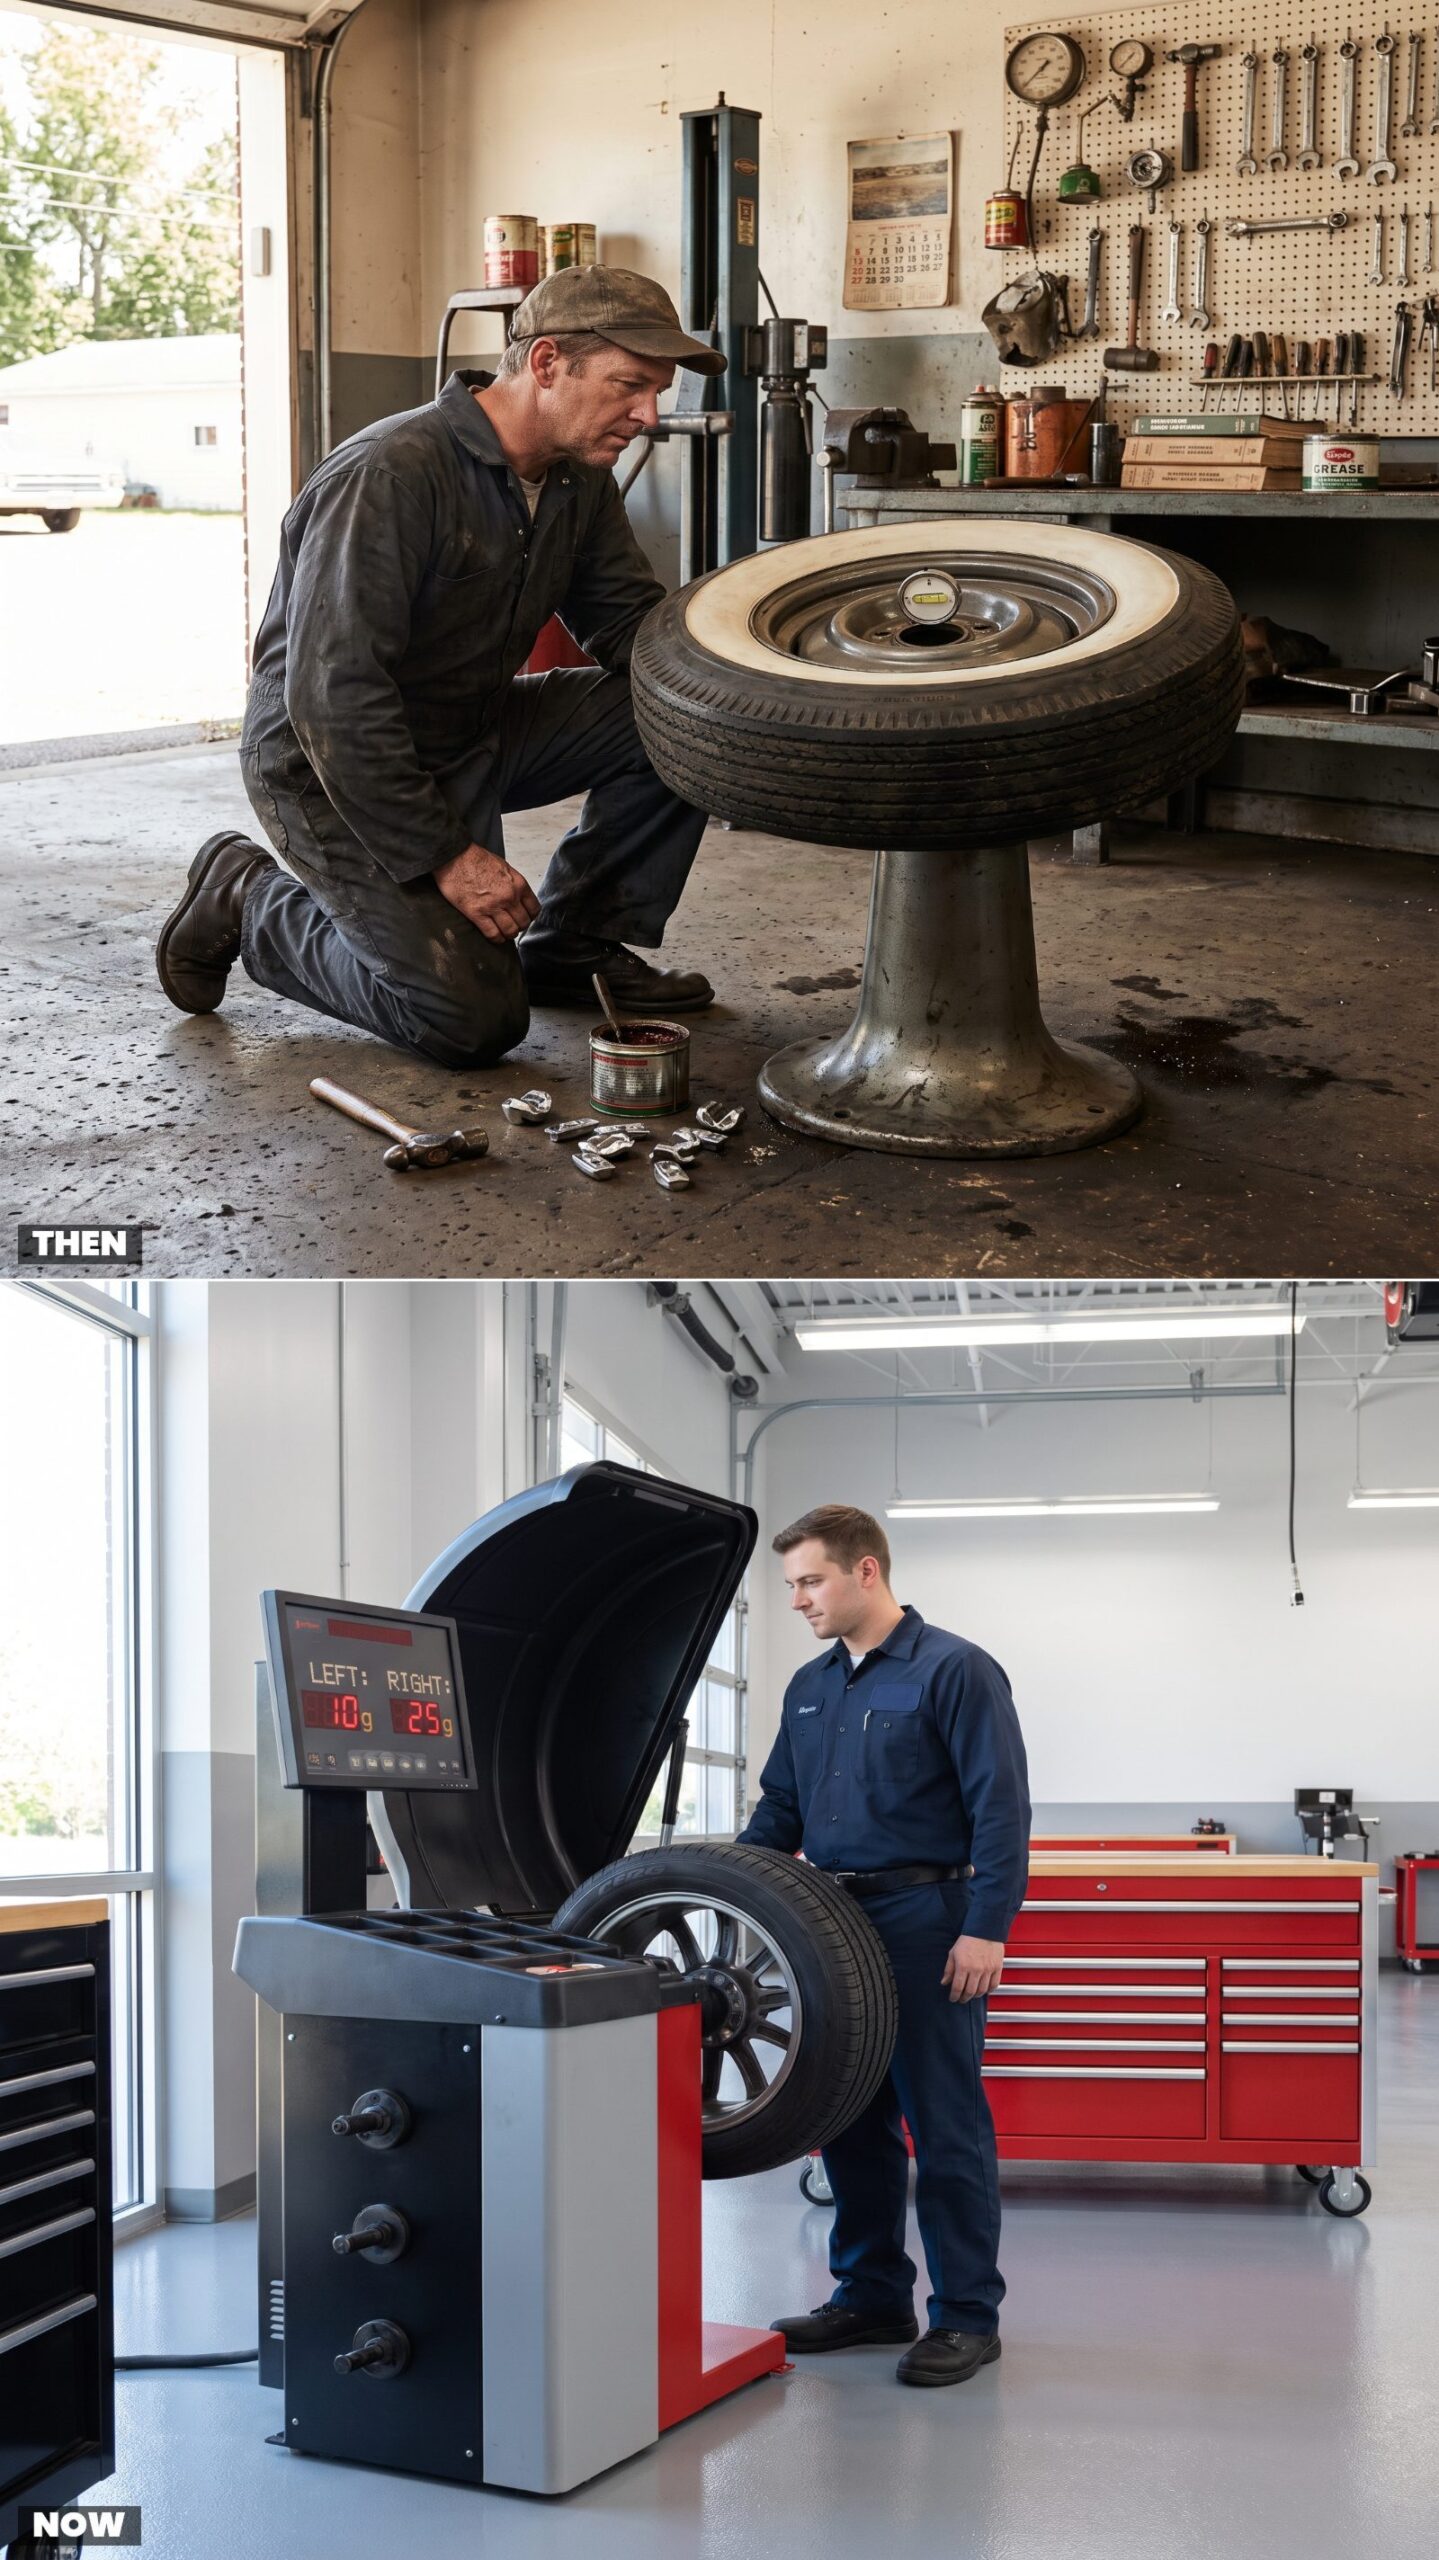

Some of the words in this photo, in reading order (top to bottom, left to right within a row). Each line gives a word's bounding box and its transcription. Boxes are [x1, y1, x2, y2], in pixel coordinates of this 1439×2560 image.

[1314, 464, 1364, 474] GREASE
[309, 1662, 368, 1687] LEFT:
[386, 1670, 451, 1695] RIGHT:
